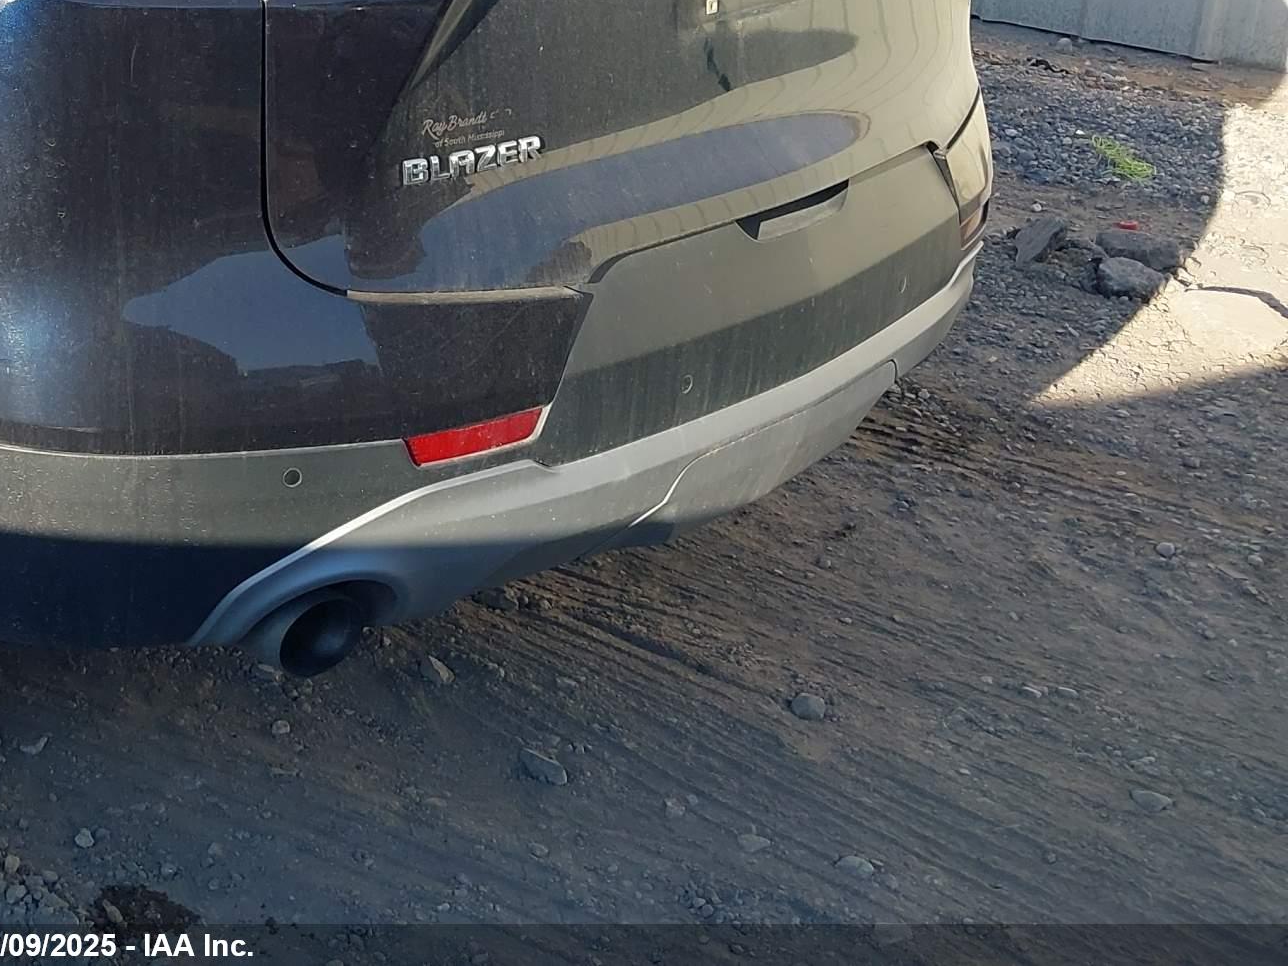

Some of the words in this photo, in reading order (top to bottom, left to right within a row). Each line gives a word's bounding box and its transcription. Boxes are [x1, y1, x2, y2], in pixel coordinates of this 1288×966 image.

[421, 118, 448, 141] Ray
[433, 138, 443, 148] of
[444, 135, 466, 147] South
[401, 135, 542, 186] BLAZER
